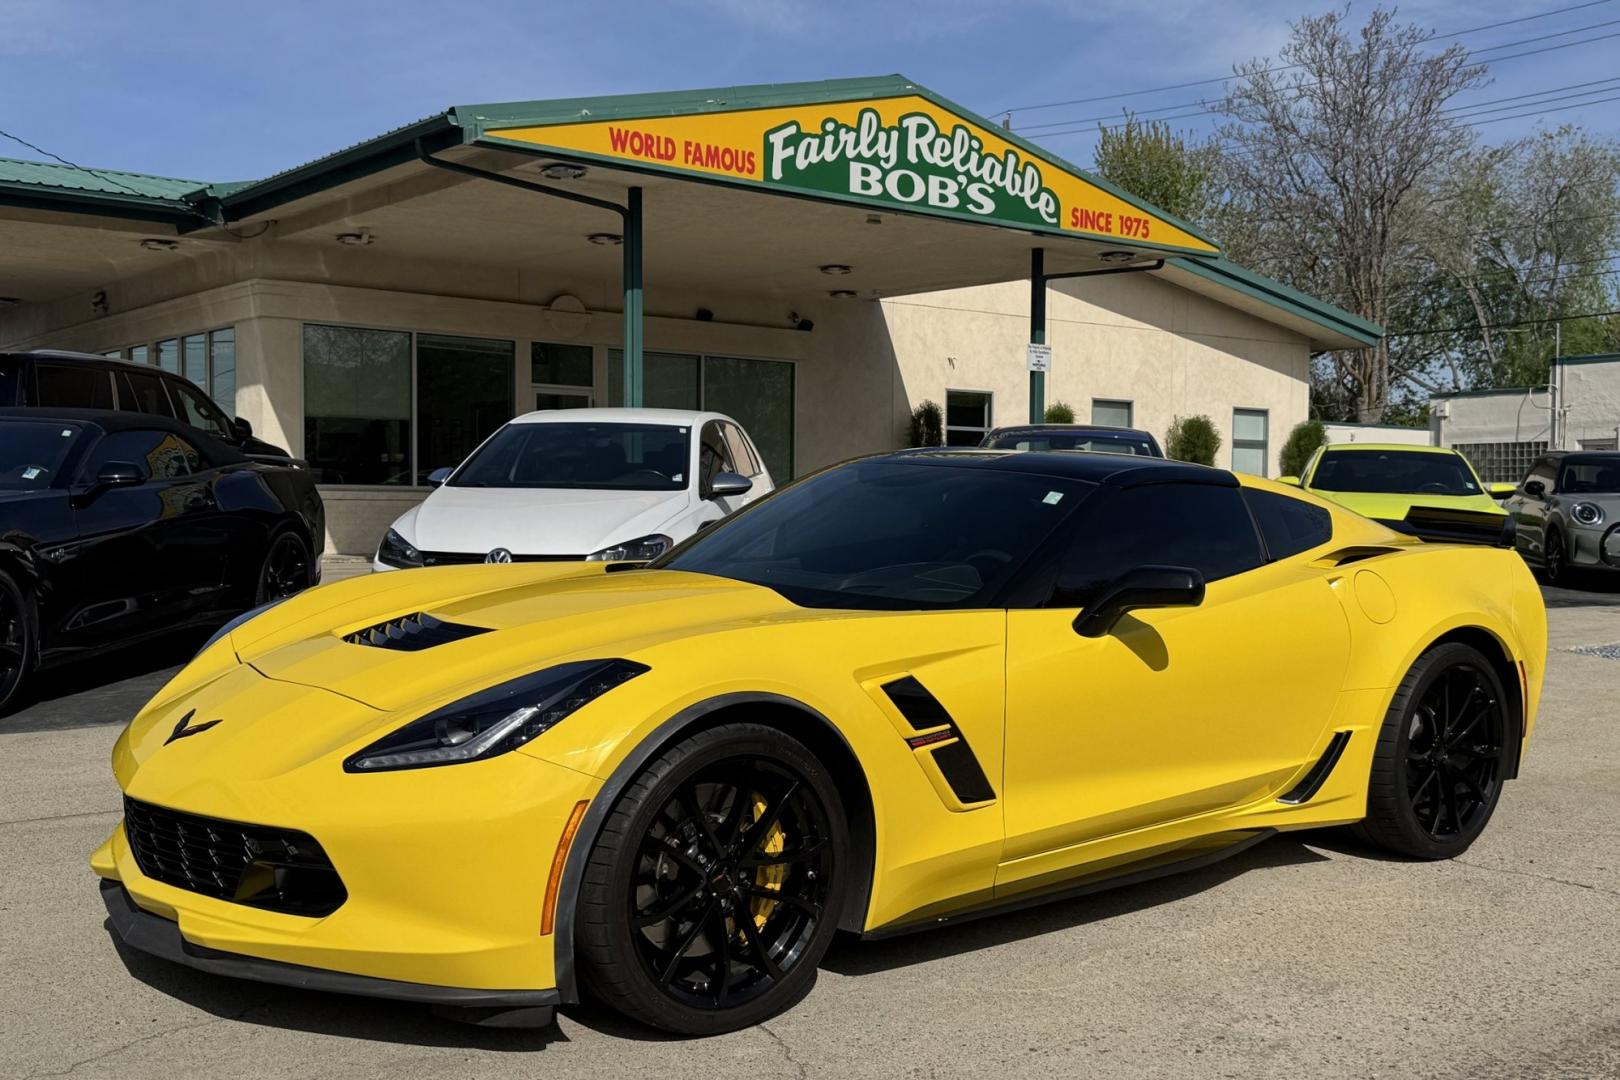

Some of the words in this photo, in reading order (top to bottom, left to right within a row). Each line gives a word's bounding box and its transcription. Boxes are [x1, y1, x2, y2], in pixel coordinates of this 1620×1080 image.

[609, 127, 676, 161] WORLD
[684, 140, 756, 175] FAMOUS
[769, 111, 899, 181] Fairly
[902, 115, 1057, 224] Reliable
[849, 162, 997, 215] BOB'S
[1071, 207, 1112, 232] SINCE
[1119, 215, 1150, 239] 1975
